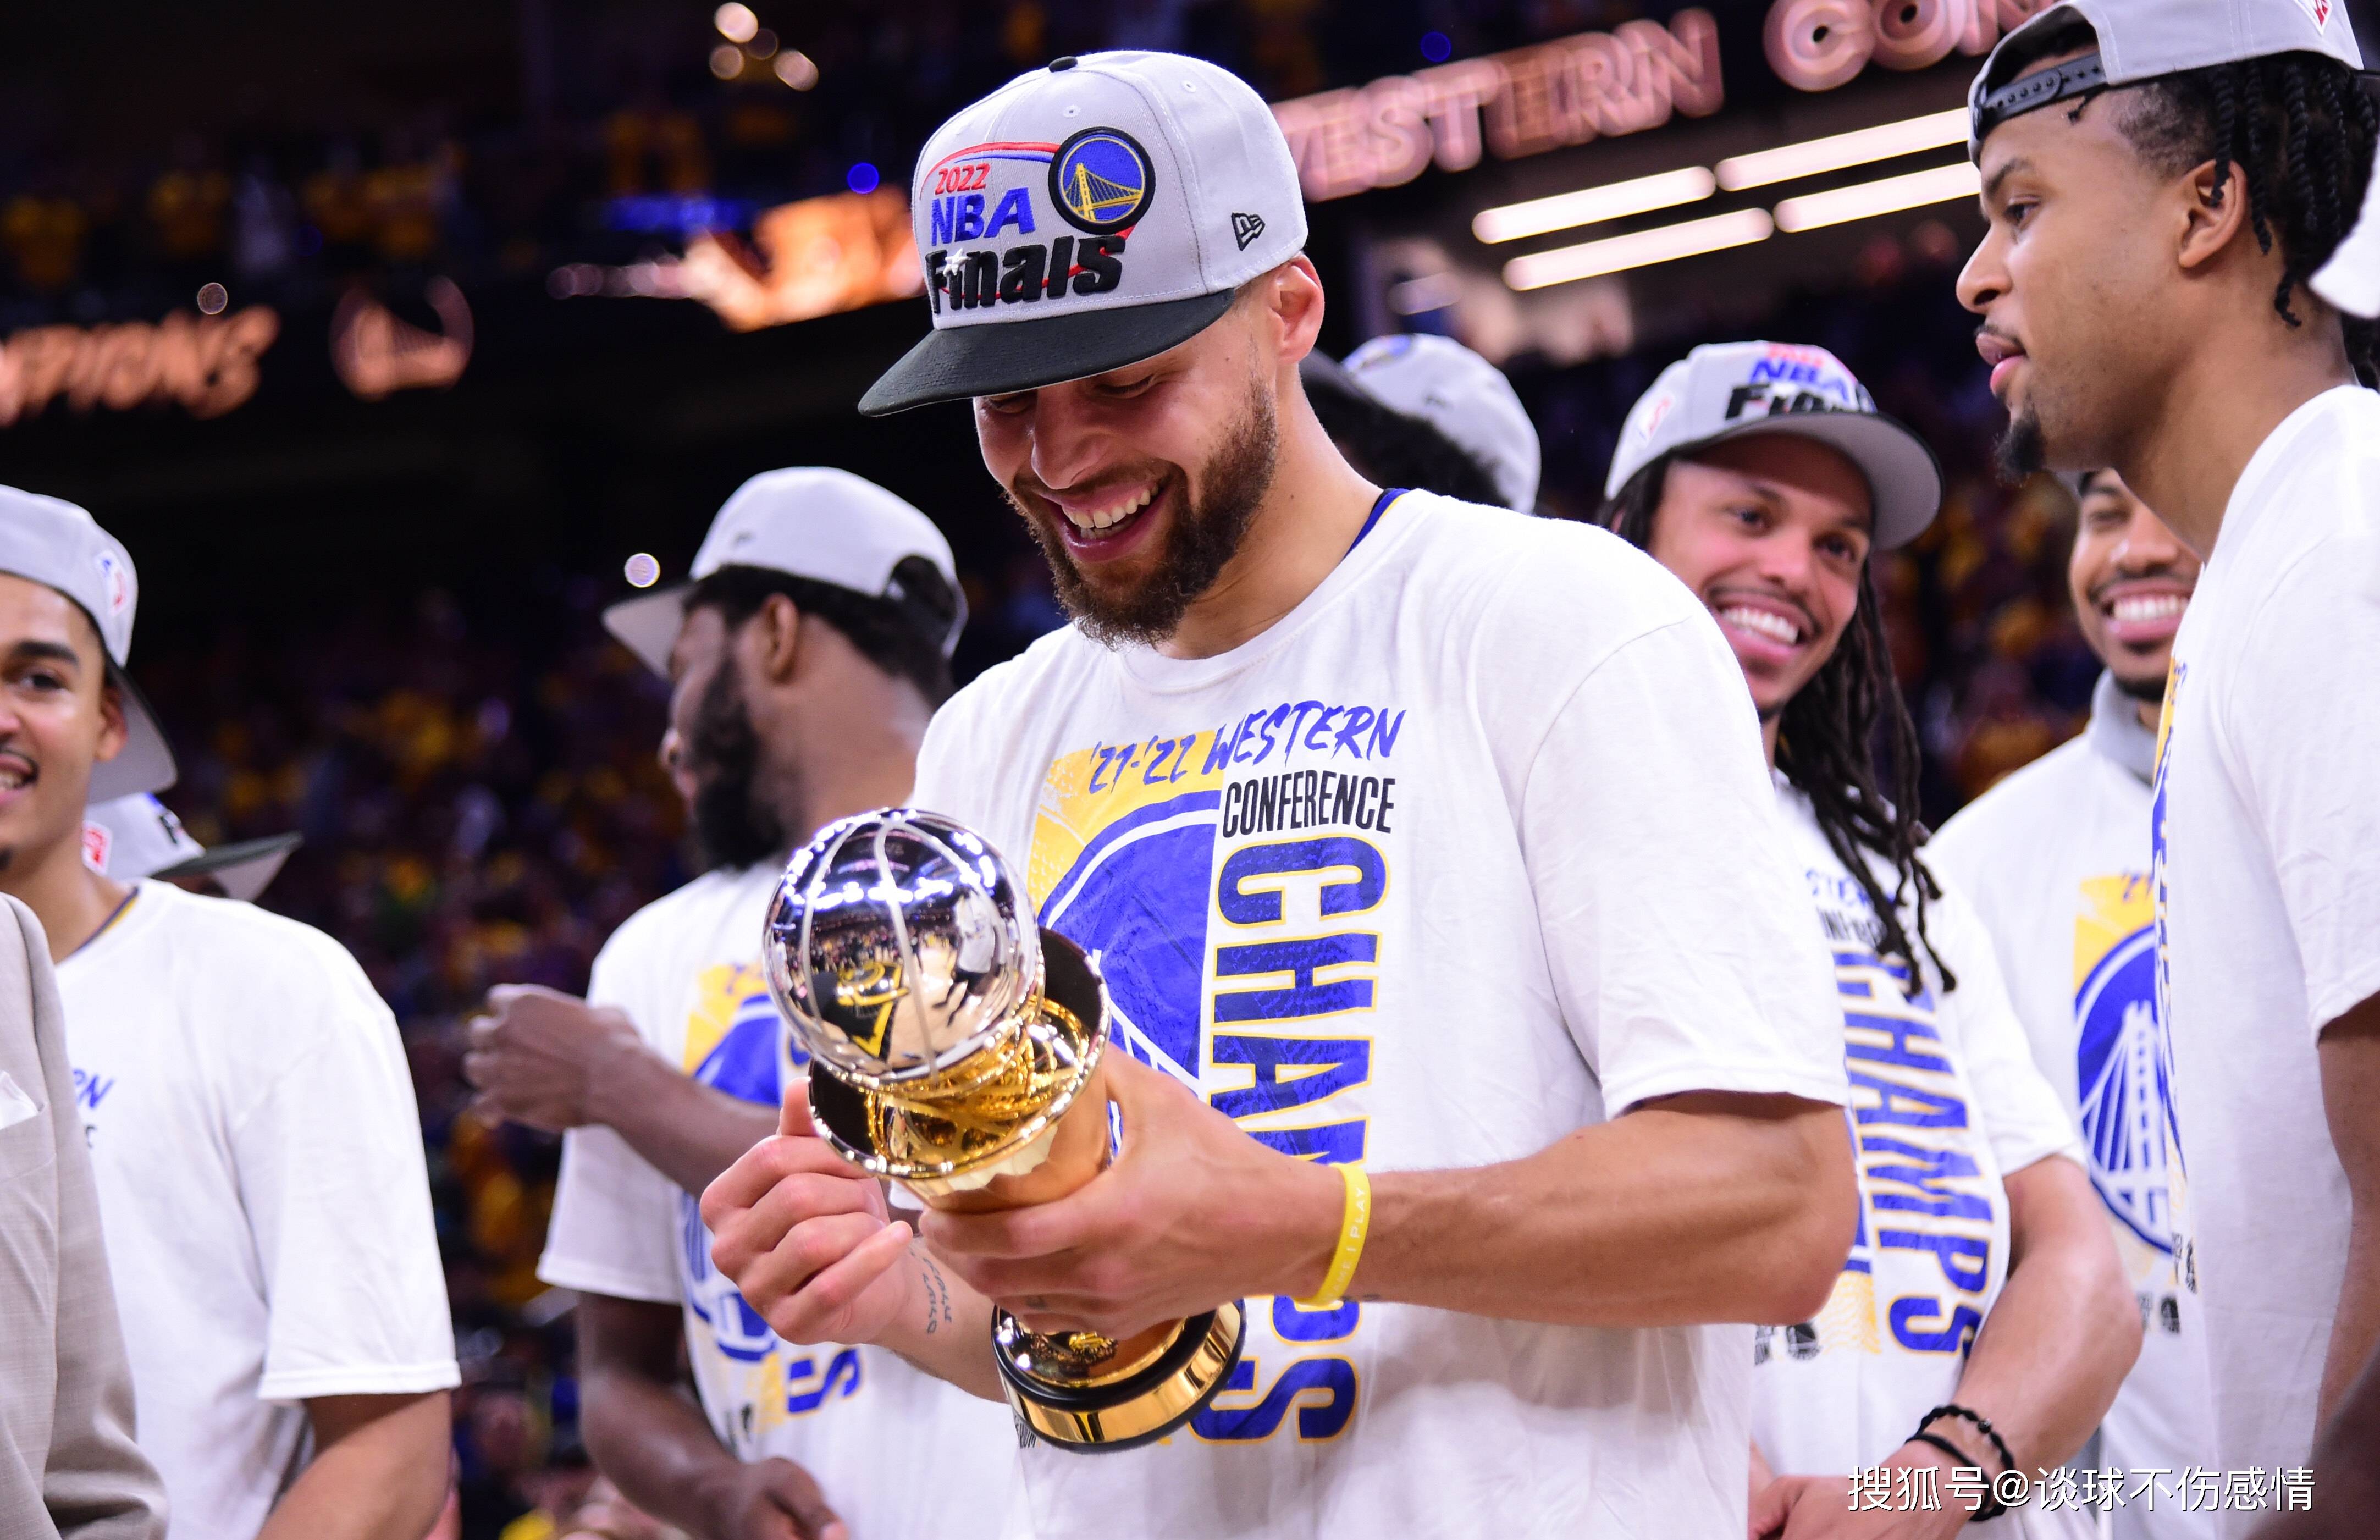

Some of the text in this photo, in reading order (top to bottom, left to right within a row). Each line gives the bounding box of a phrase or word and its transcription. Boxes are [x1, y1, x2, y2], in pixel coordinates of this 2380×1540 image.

[935, 163, 990, 195] 2022
[931, 187, 1036, 246] NBA
[925, 235, 1126, 315] Finals
[1202, 699, 1407, 776] WESTERN
[1222, 769, 1396, 838] CONFERENCE
[1350, 1186, 1366, 1239] PLAY
